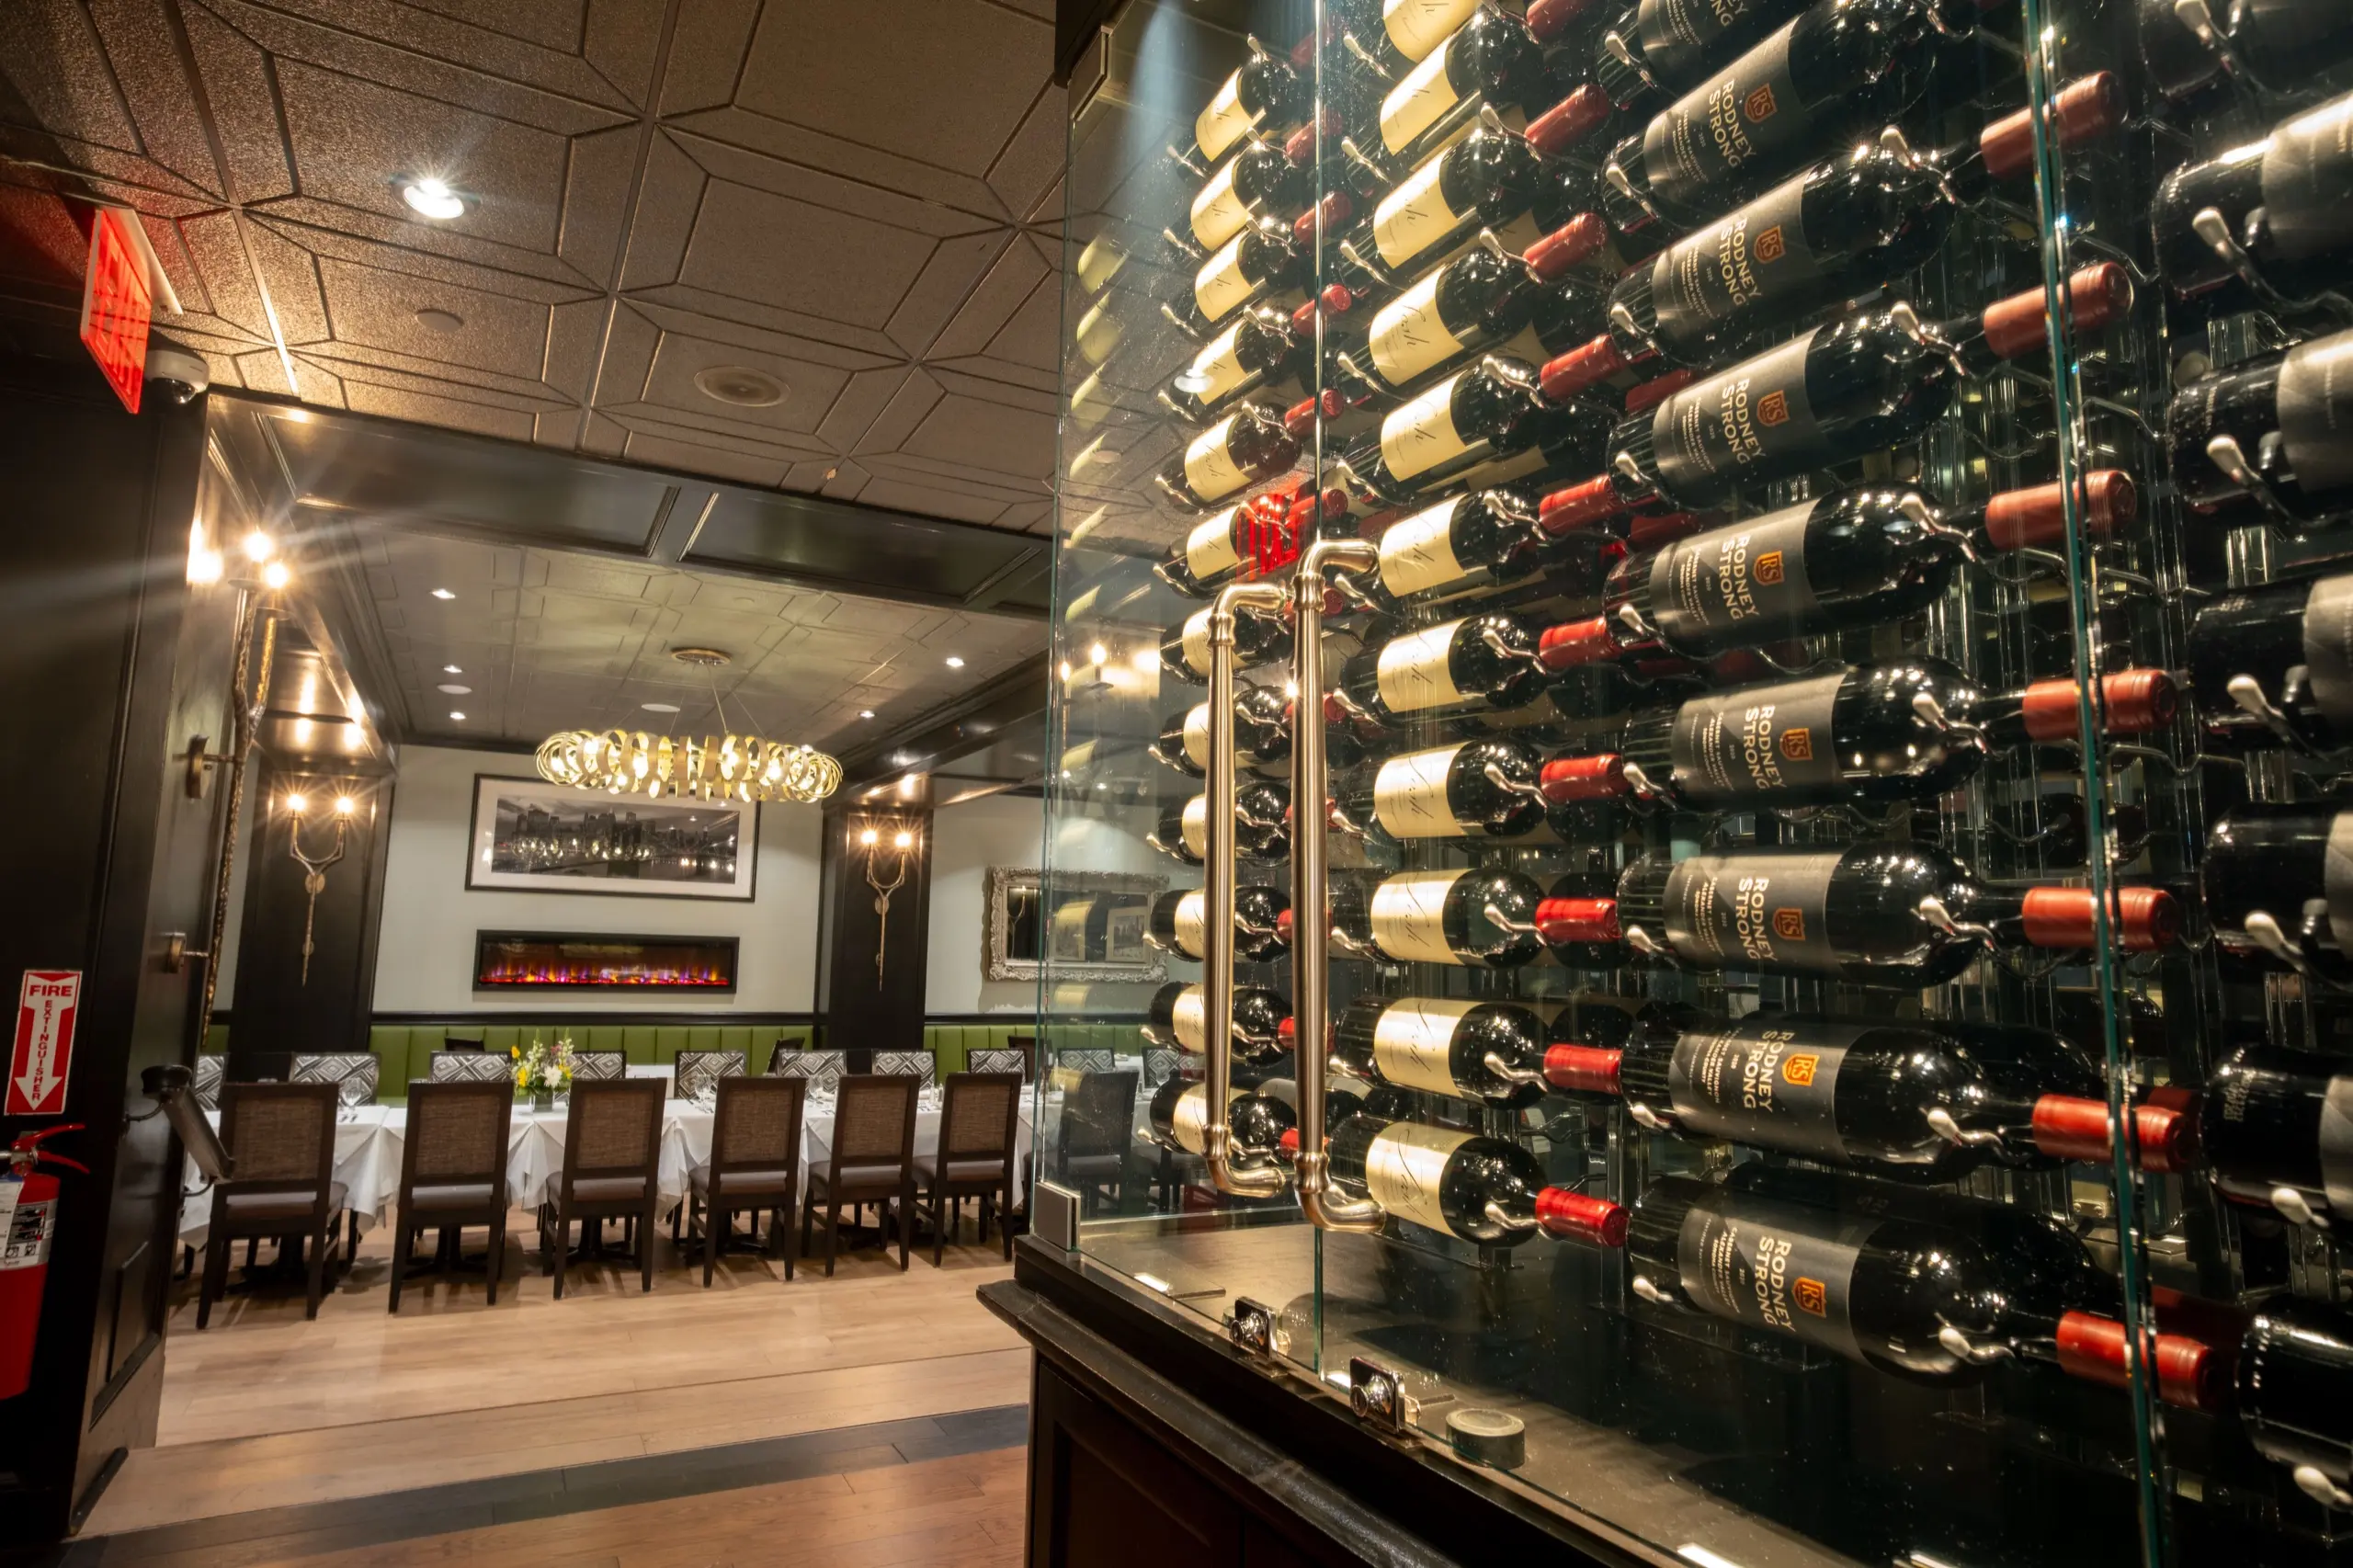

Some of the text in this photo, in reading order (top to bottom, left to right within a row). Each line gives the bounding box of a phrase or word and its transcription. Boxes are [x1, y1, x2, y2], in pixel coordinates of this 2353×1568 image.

[1709, 89, 1741, 167] STRONG
[1722, 78, 1756, 157] RODNEY
[1752, 92, 1770, 116] RS
[1720, 229, 1746, 305] STRONG
[1733, 219, 1761, 297] RODNEY
[1762, 233, 1779, 257] RS
[1721, 385, 1750, 464] STRONG
[1735, 379, 1767, 457] RODNEY
[1765, 398, 1781, 421] RS
[1719, 540, 1744, 619] STRONG
[1733, 535, 1760, 616] RODNEY
[1762, 557, 1779, 581] RS
[1744, 706, 1770, 790] STRONG
[1758, 704, 1787, 788] RODNEY
[1789, 734, 1806, 756] RS
[1736, 878, 1760, 960] STRONG
[1751, 878, 1778, 961] RODNEY
[1782, 915, 1800, 934] RS
[29, 985, 73, 996] FIRE
[32, 1000, 52, 1101] EXTINGUISHER
[1743, 1030, 1770, 1109] STRONG
[1758, 1031, 1794, 1112] RODNEY
[1791, 1059, 1812, 1079] RS
[1755, 1236, 1779, 1325] STRONG
[1771, 1239, 1796, 1332] RODNEY
[1802, 1284, 1820, 1311] RS
